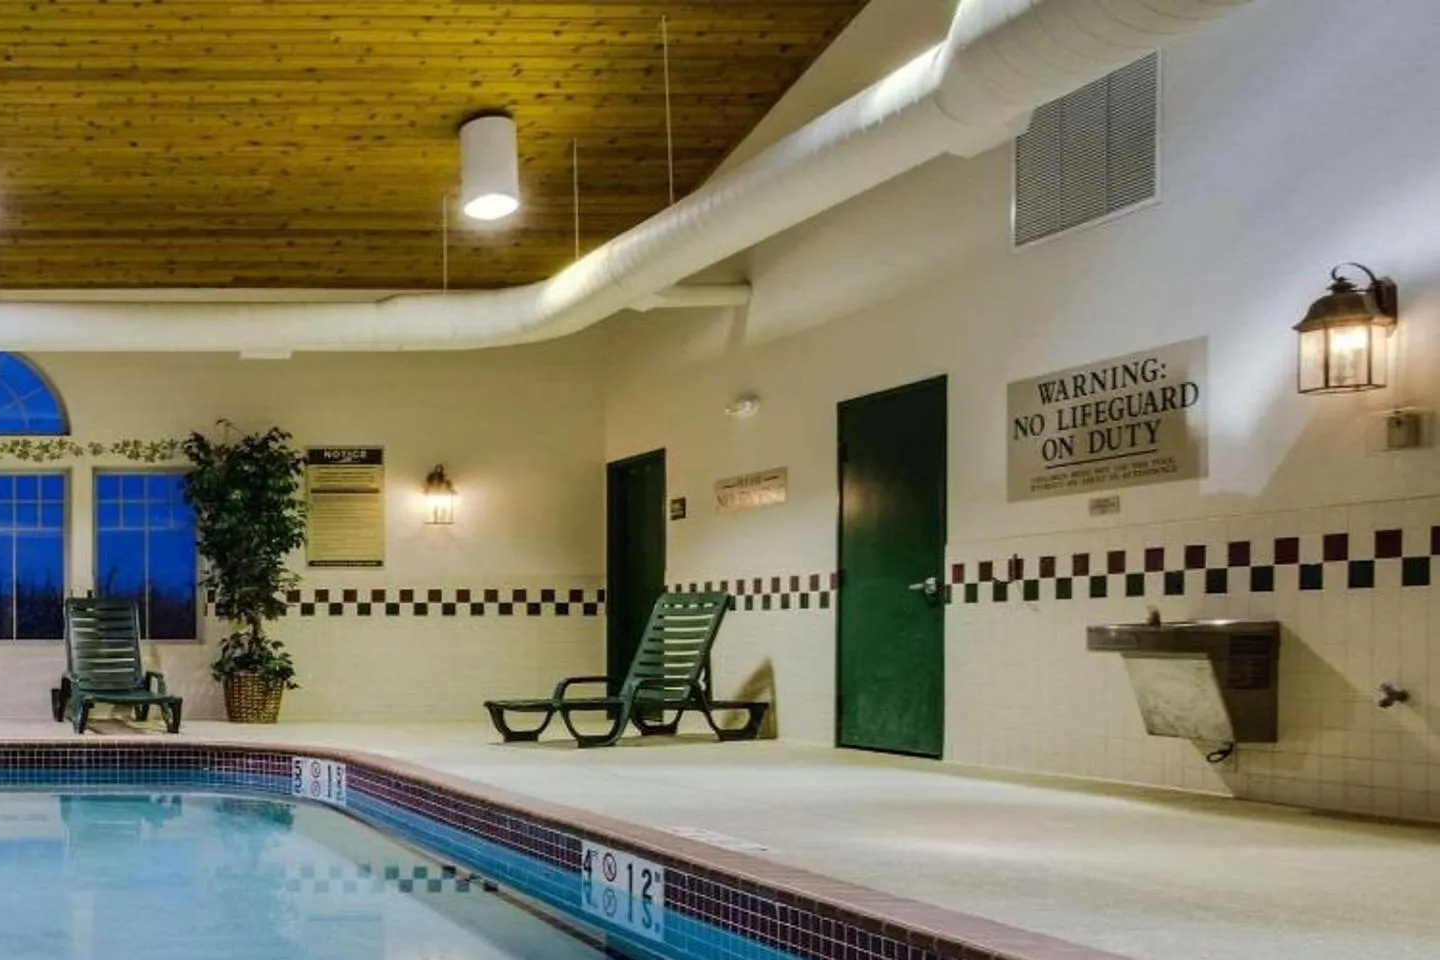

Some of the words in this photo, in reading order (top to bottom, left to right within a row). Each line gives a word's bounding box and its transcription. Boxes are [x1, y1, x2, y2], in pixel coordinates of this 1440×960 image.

[1038, 358, 1167, 405] WARNING:
[1013, 414, 1046, 441] NO
[1057, 381, 1200, 431] LIFEGUARD
[323, 450, 367, 459] NOTICE
[1042, 435, 1074, 462] ON
[1088, 419, 1163, 454] DUTY
